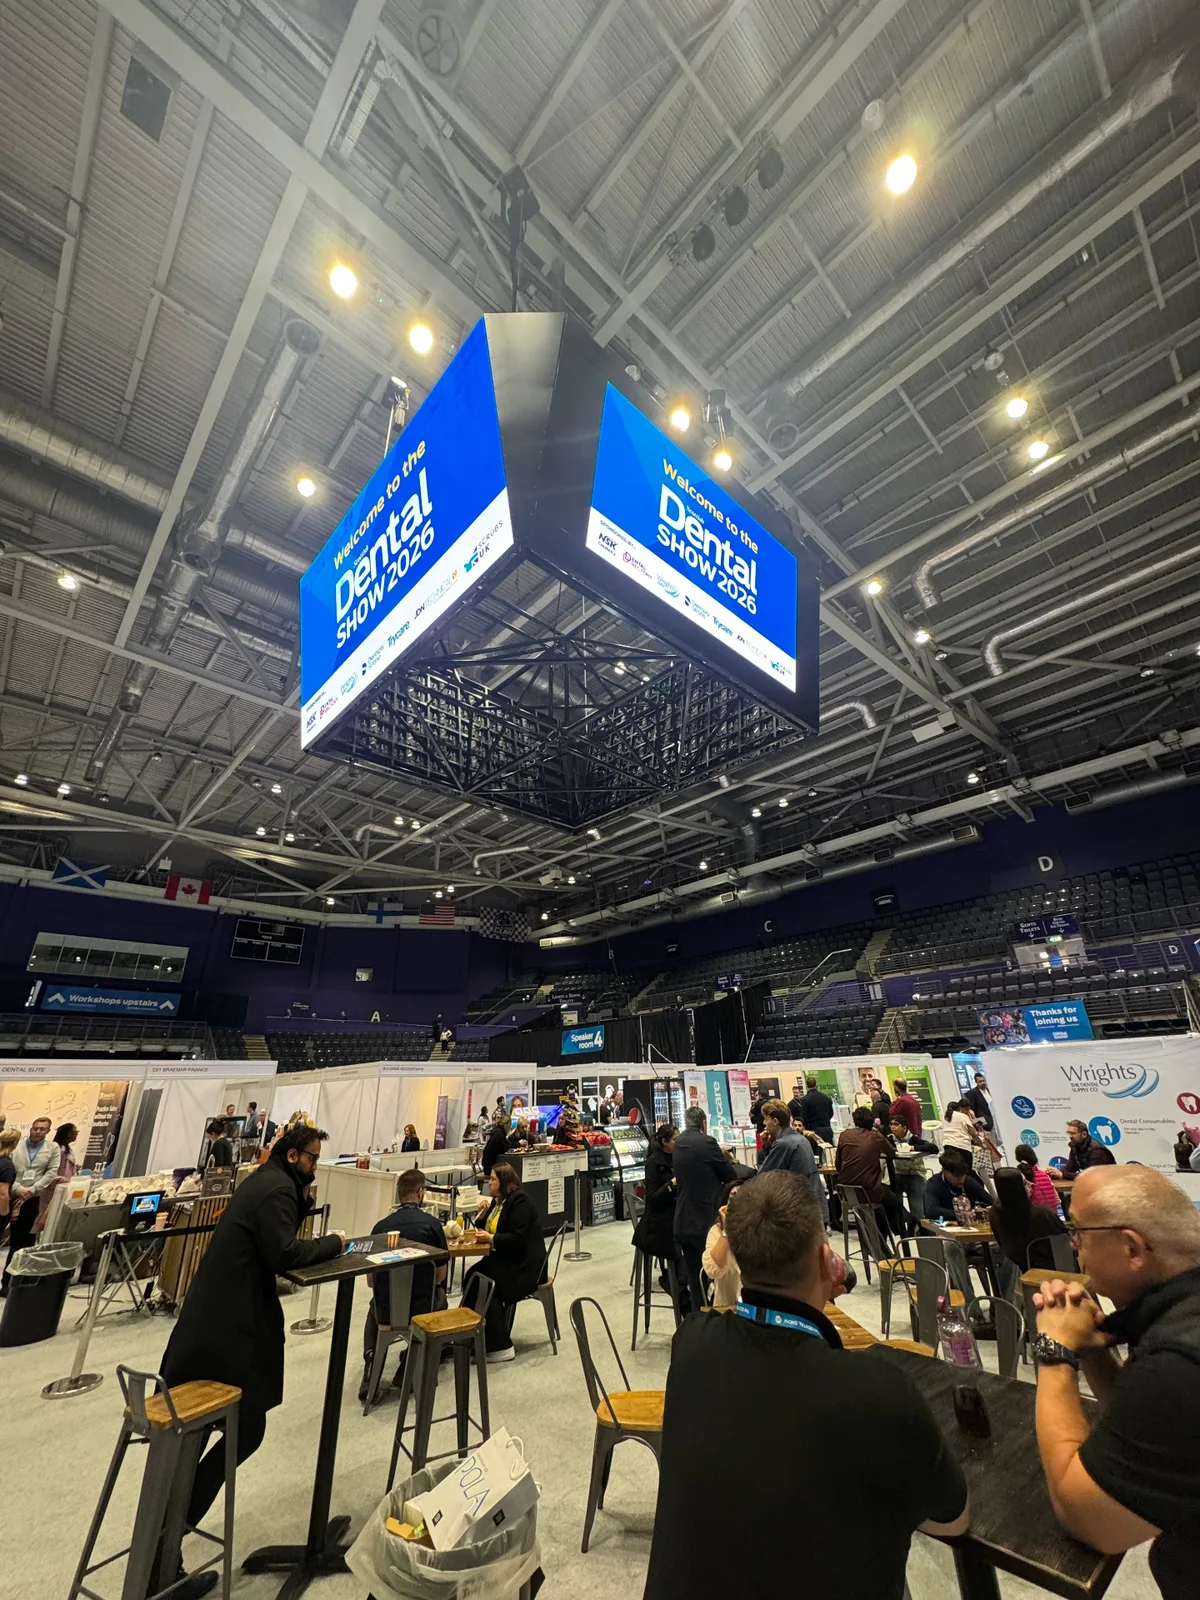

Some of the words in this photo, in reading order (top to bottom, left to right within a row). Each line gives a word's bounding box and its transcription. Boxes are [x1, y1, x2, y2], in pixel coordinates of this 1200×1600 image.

[334, 495, 385, 570] Welcome
[386, 474, 401, 499] to
[402, 440, 426, 478] the
[662, 458, 724, 524] Welcome
[725, 516, 739, 536] to
[740, 529, 759, 555] the
[477, 520, 504, 549] SCRUBS
[598, 532, 619, 551] NSK
[659, 483, 758, 596] Dental
[335, 467, 434, 624] Dental
[479, 542, 491, 558] UK
[656, 523, 718, 583] SHOW
[717, 571, 758, 615] 2026
[336, 574, 386, 649] SHOW
[386, 519, 435, 593] 2026
[386, 621, 411, 648] Trycare
[713, 616, 734, 636] Trycare
[1037, 856, 1054, 872] D
[764, 920, 772, 932] C
[1168, 945, 1179, 954] D
[69, 994, 122, 1005] Workshops
[122, 999, 158, 1007] upstairs
[371, 1011, 381, 1022] A
[1029, 1007, 1063, 1017] Thanks
[1034, 1016, 1066, 1026] joining
[571, 1032, 594, 1042] Speaker
[578, 1041, 594, 1049] room
[594, 1030, 603, 1047] 4
[1060, 1062, 1137, 1087] Wrights
[594, 1191, 613, 1205] REAL
